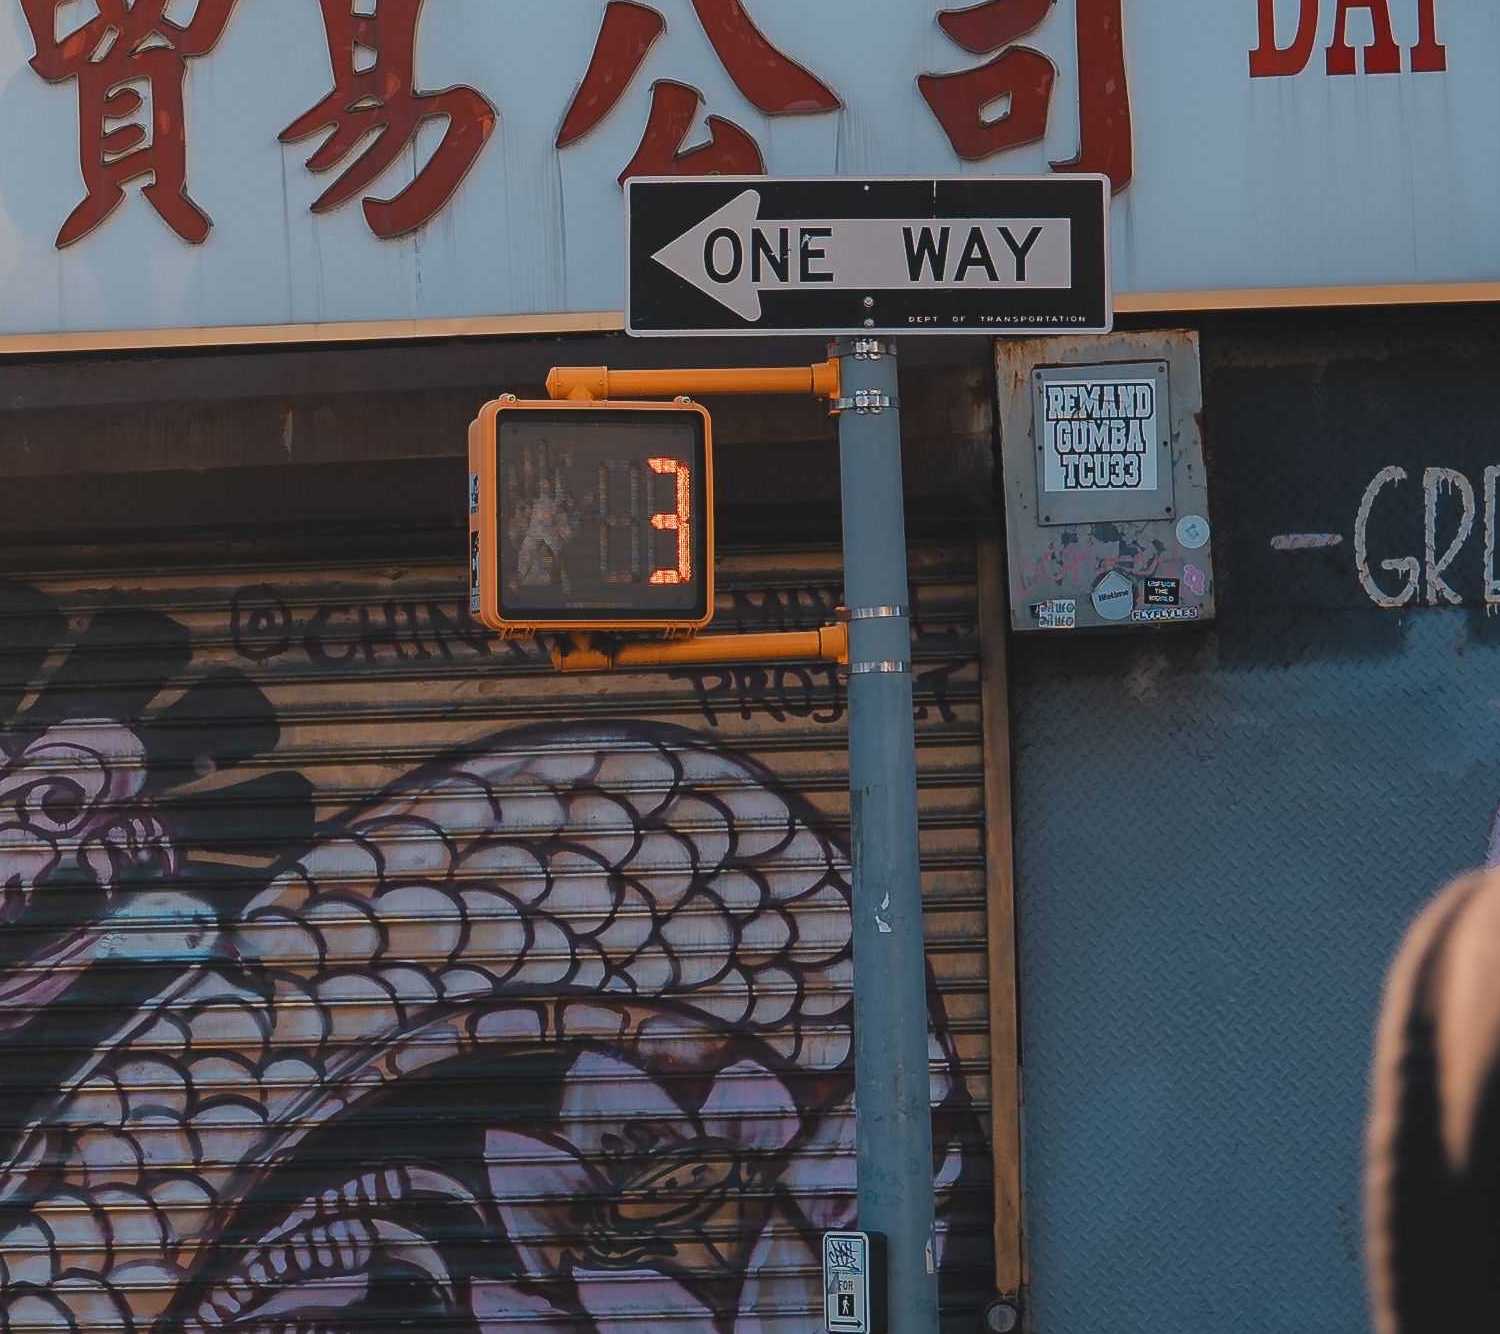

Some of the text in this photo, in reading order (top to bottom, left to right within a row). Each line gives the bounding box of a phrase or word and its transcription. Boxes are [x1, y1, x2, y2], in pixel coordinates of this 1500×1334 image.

[702, 225, 1045, 284] ONE WAY
[908, 315, 1087, 323] DEPT OF TRANSPORTATION
[1046, 383, 1154, 421] REMAND
[1054, 419, 1147, 454] GUMBA
[1060, 452, 1143, 489] TCU33
[647, 456, 692, 586] 3
[837, 1279, 854, 1292] FOR
